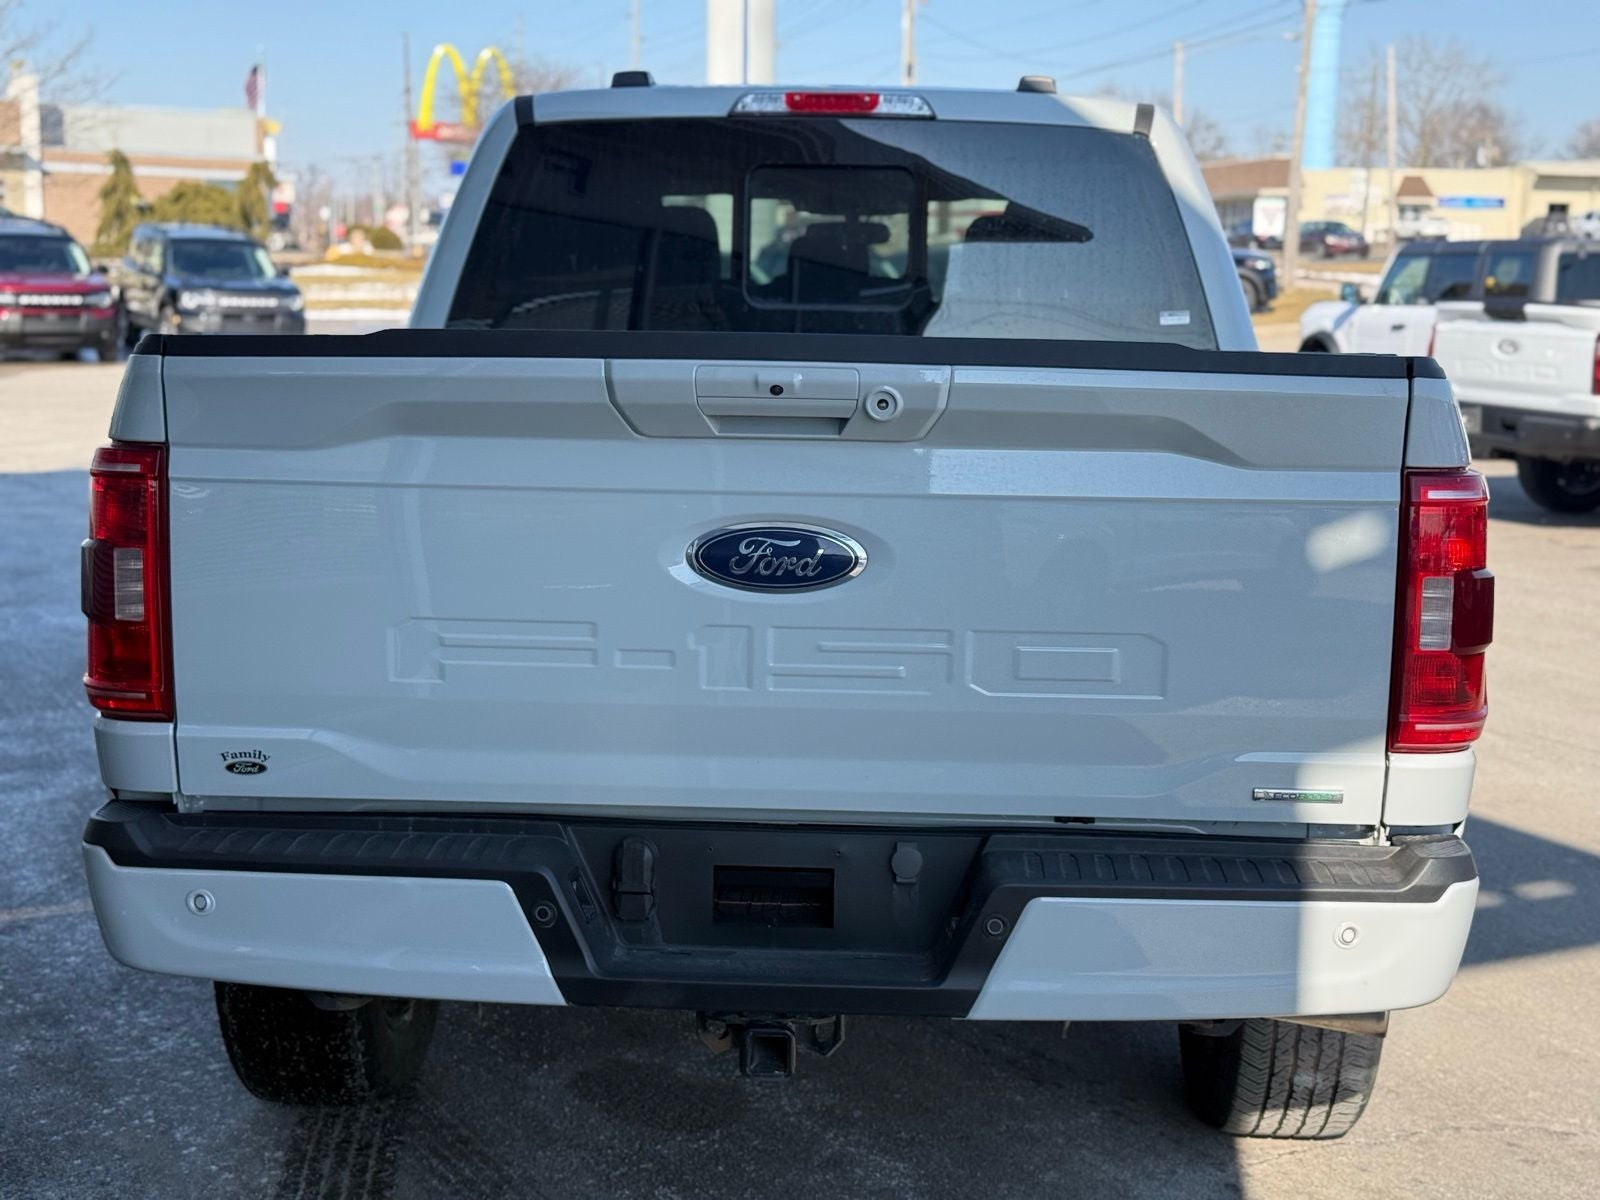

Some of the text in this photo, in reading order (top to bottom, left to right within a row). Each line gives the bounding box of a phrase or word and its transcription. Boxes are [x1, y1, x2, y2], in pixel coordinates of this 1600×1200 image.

[729, 537, 825, 577] Ford
[386, 617, 1167, 699] F-150
[220, 749, 271, 763] Family
[233, 762, 260, 773] Ford
